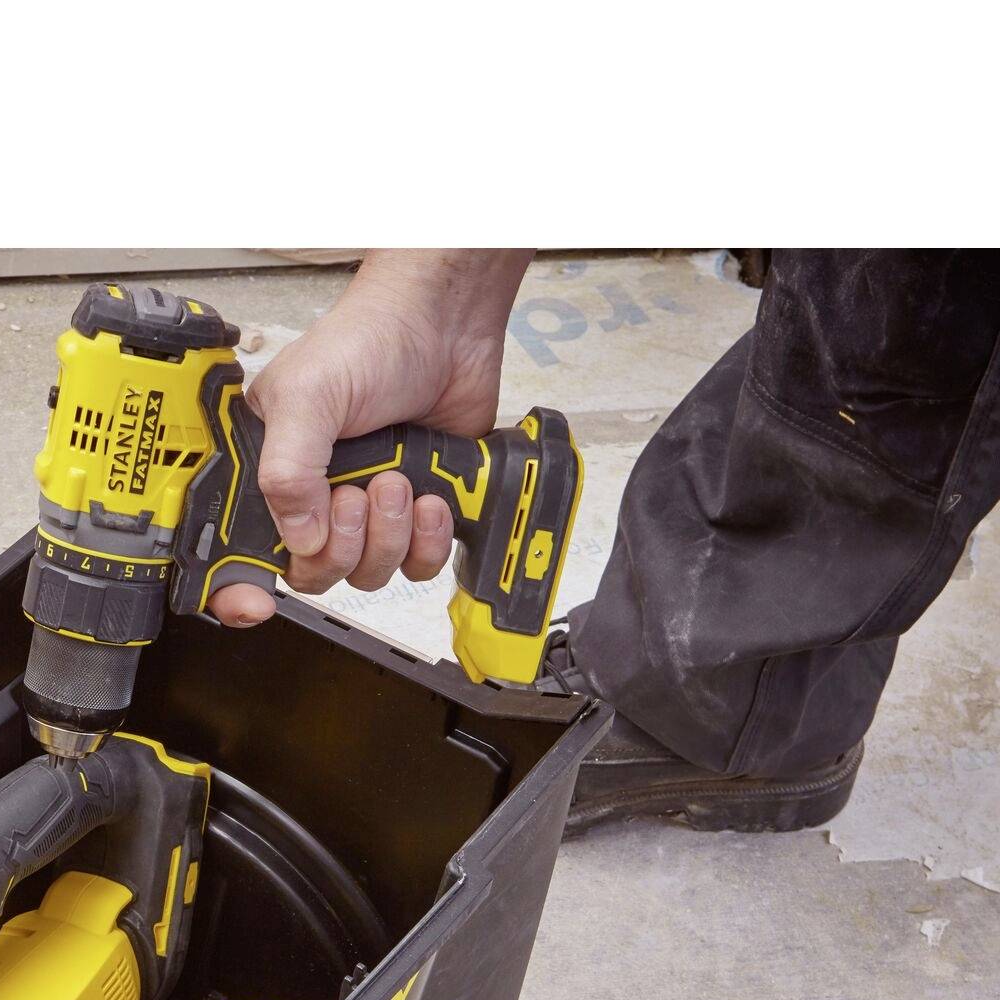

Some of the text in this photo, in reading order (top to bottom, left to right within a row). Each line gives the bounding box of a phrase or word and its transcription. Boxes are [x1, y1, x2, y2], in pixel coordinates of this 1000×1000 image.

[108, 384, 142, 493] STANLEY
[131, 396, 161, 491] FATMAX
[80, 556, 91, 570] 7
[124, 564, 135, 578] 5
